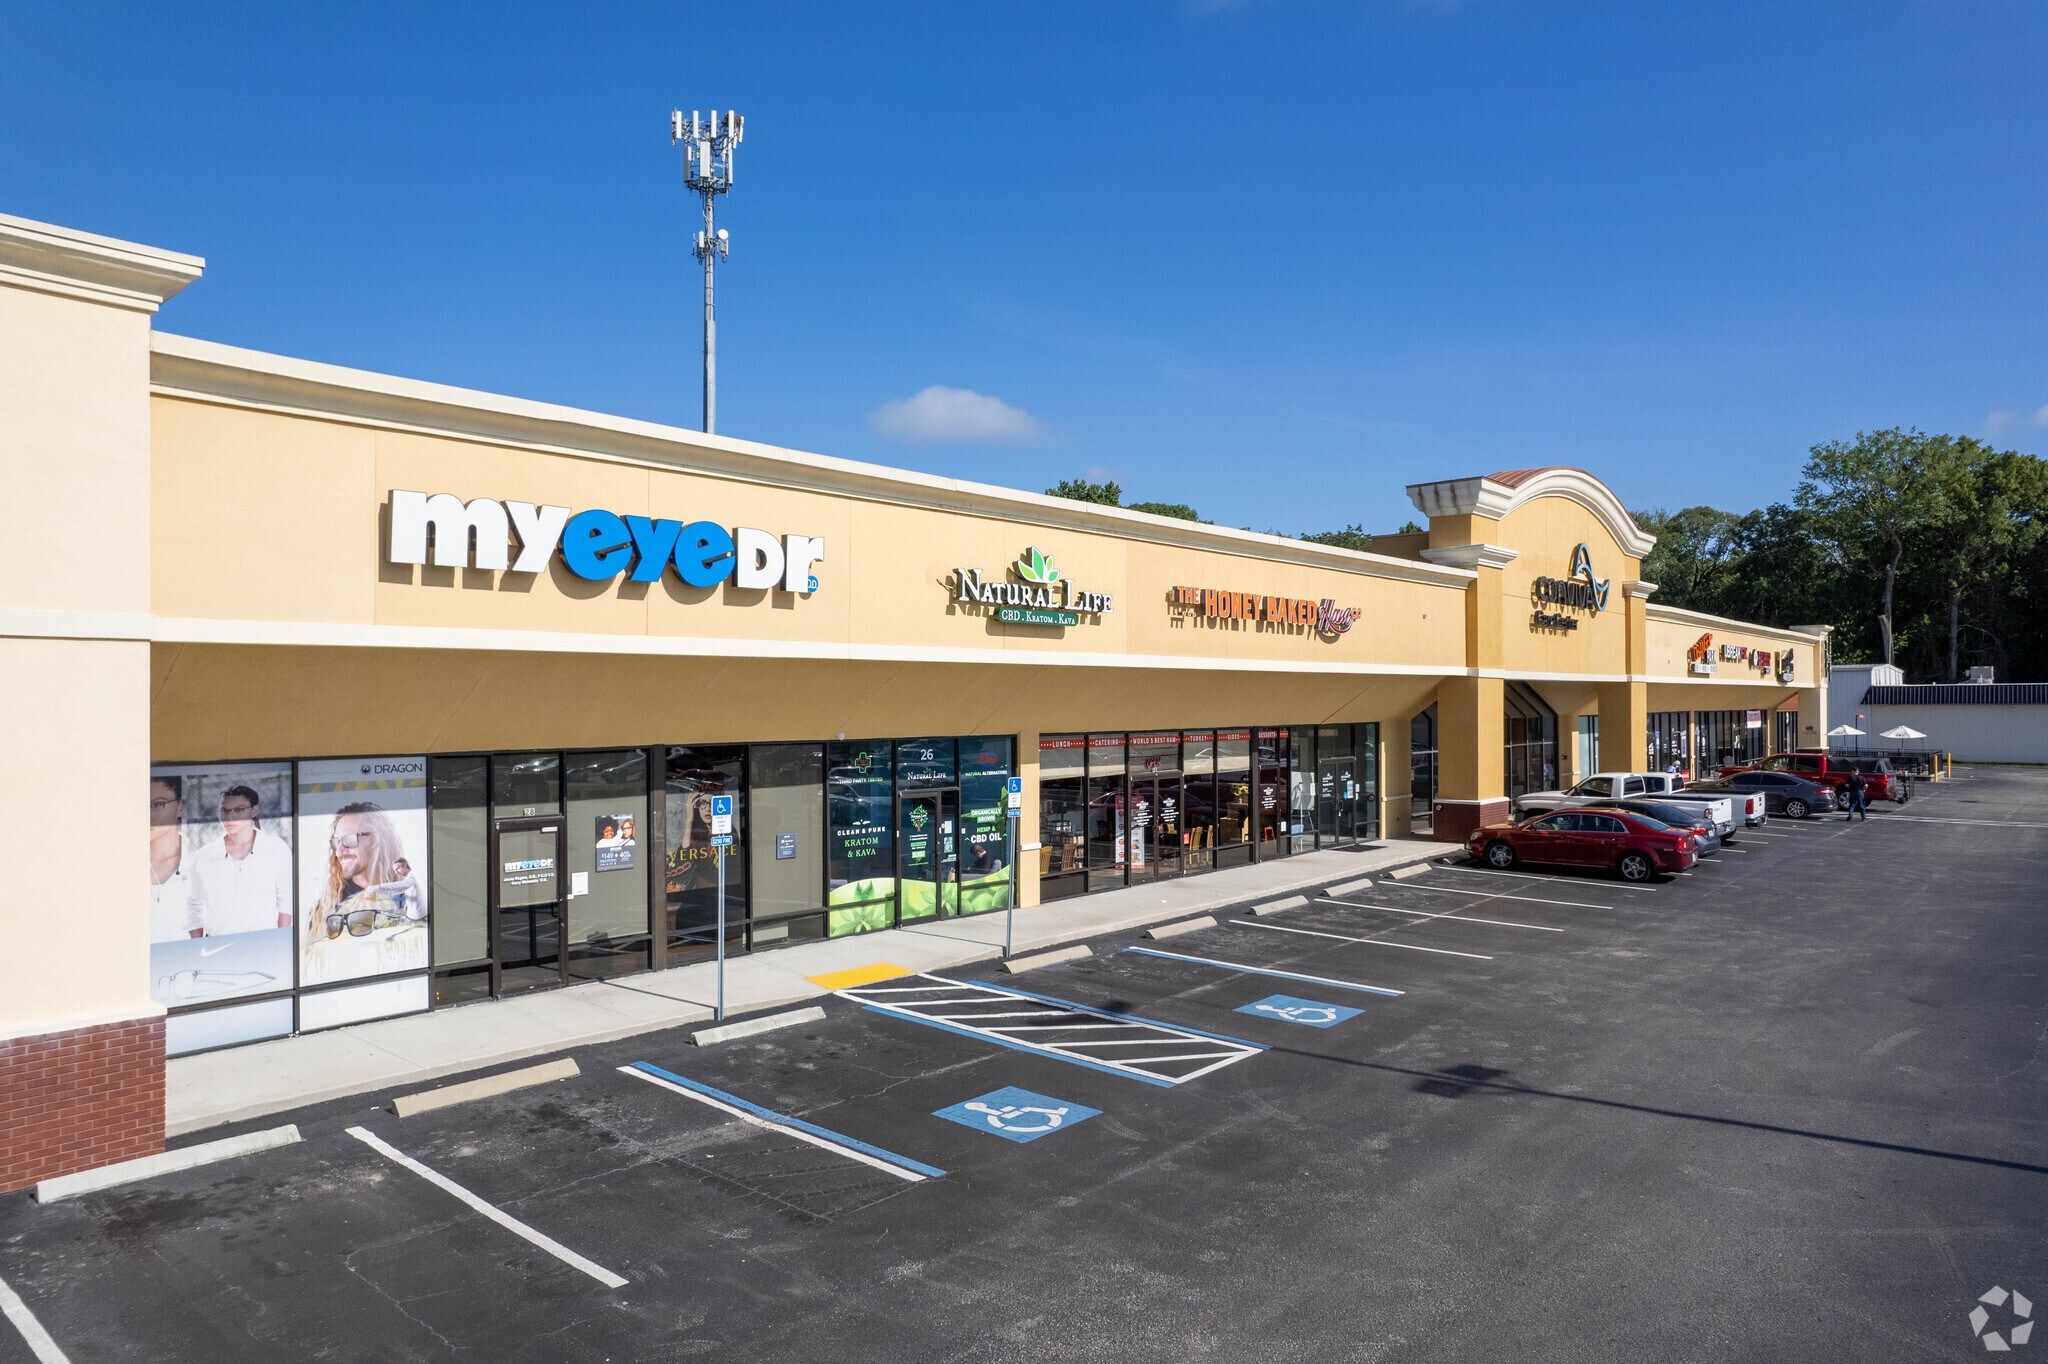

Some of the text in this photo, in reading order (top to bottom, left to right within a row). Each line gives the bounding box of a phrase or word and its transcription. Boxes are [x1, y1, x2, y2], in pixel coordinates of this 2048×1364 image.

[1178, 586, 1200, 604] THE
[1205, 588, 1262, 620] HONEY
[1267, 596, 1318, 625] BAKED
[1001, 610, 1020, 621] CBD
[920, 749, 933, 760] 26
[374, 763, 423, 774] DRAGON
[837, 828, 860, 836] CLEAN
[970, 832, 1002, 843] CBD OIL
[844, 836, 879, 847] KRATOM
[847, 848, 876, 858] & KAVA
